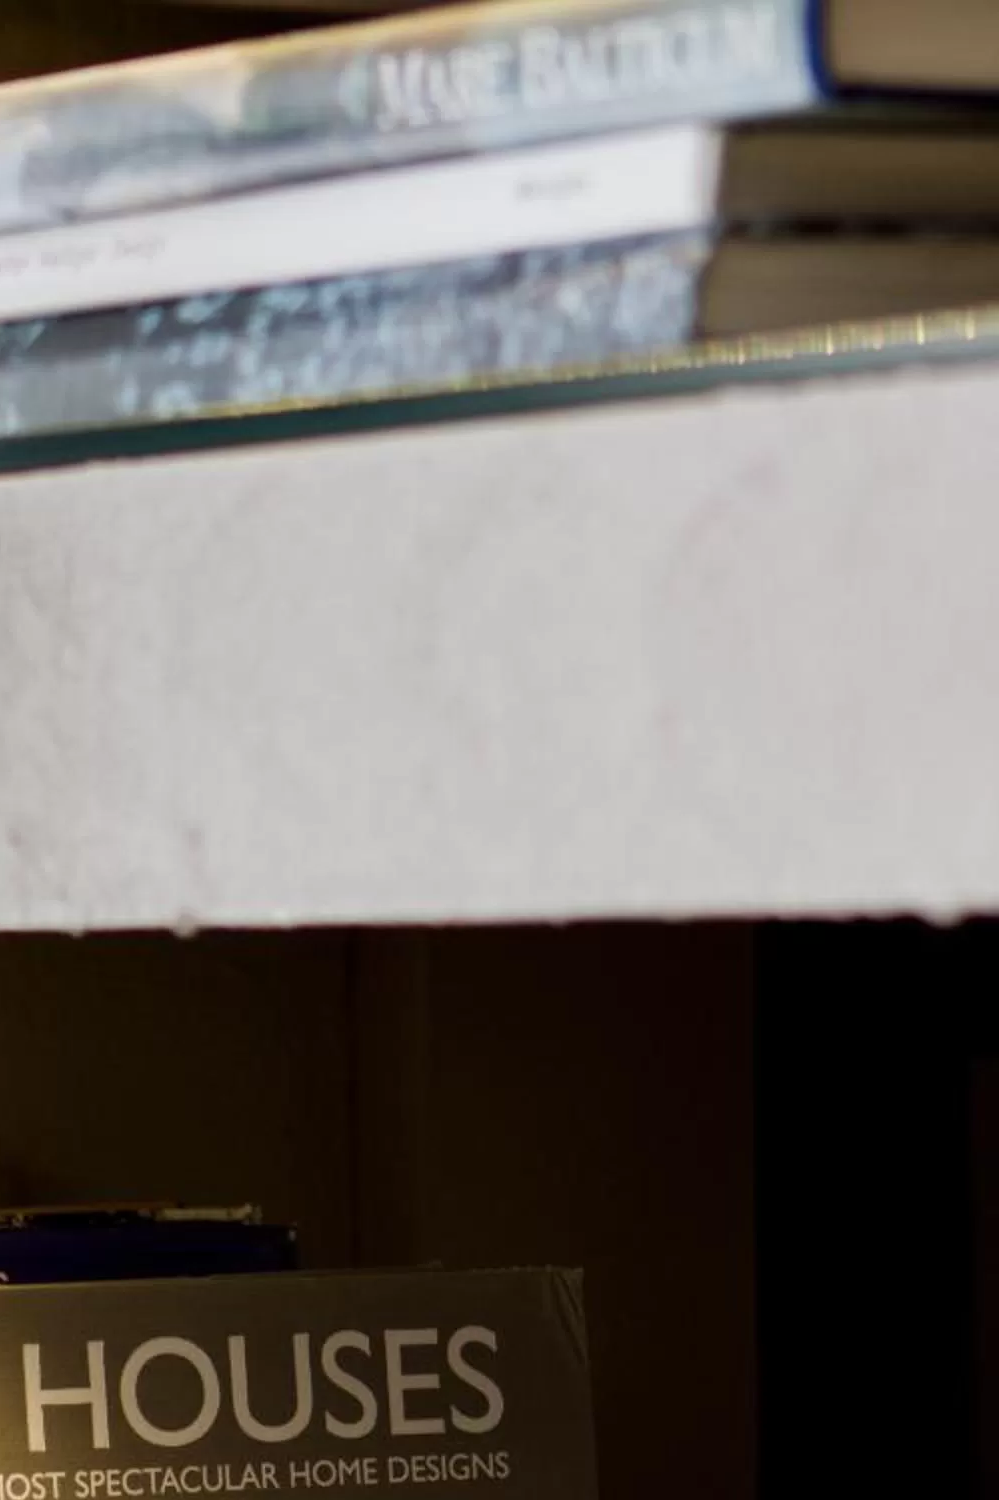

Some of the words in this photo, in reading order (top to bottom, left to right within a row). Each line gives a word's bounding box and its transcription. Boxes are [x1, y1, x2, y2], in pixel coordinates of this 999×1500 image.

[23, 1324, 505, 1453] HOUSES
[74, 1461, 279, 1500] SPECTACULAR
[288, 1456, 380, 1489] HOME
[388, 1451, 511, 1486] DESIGNS
